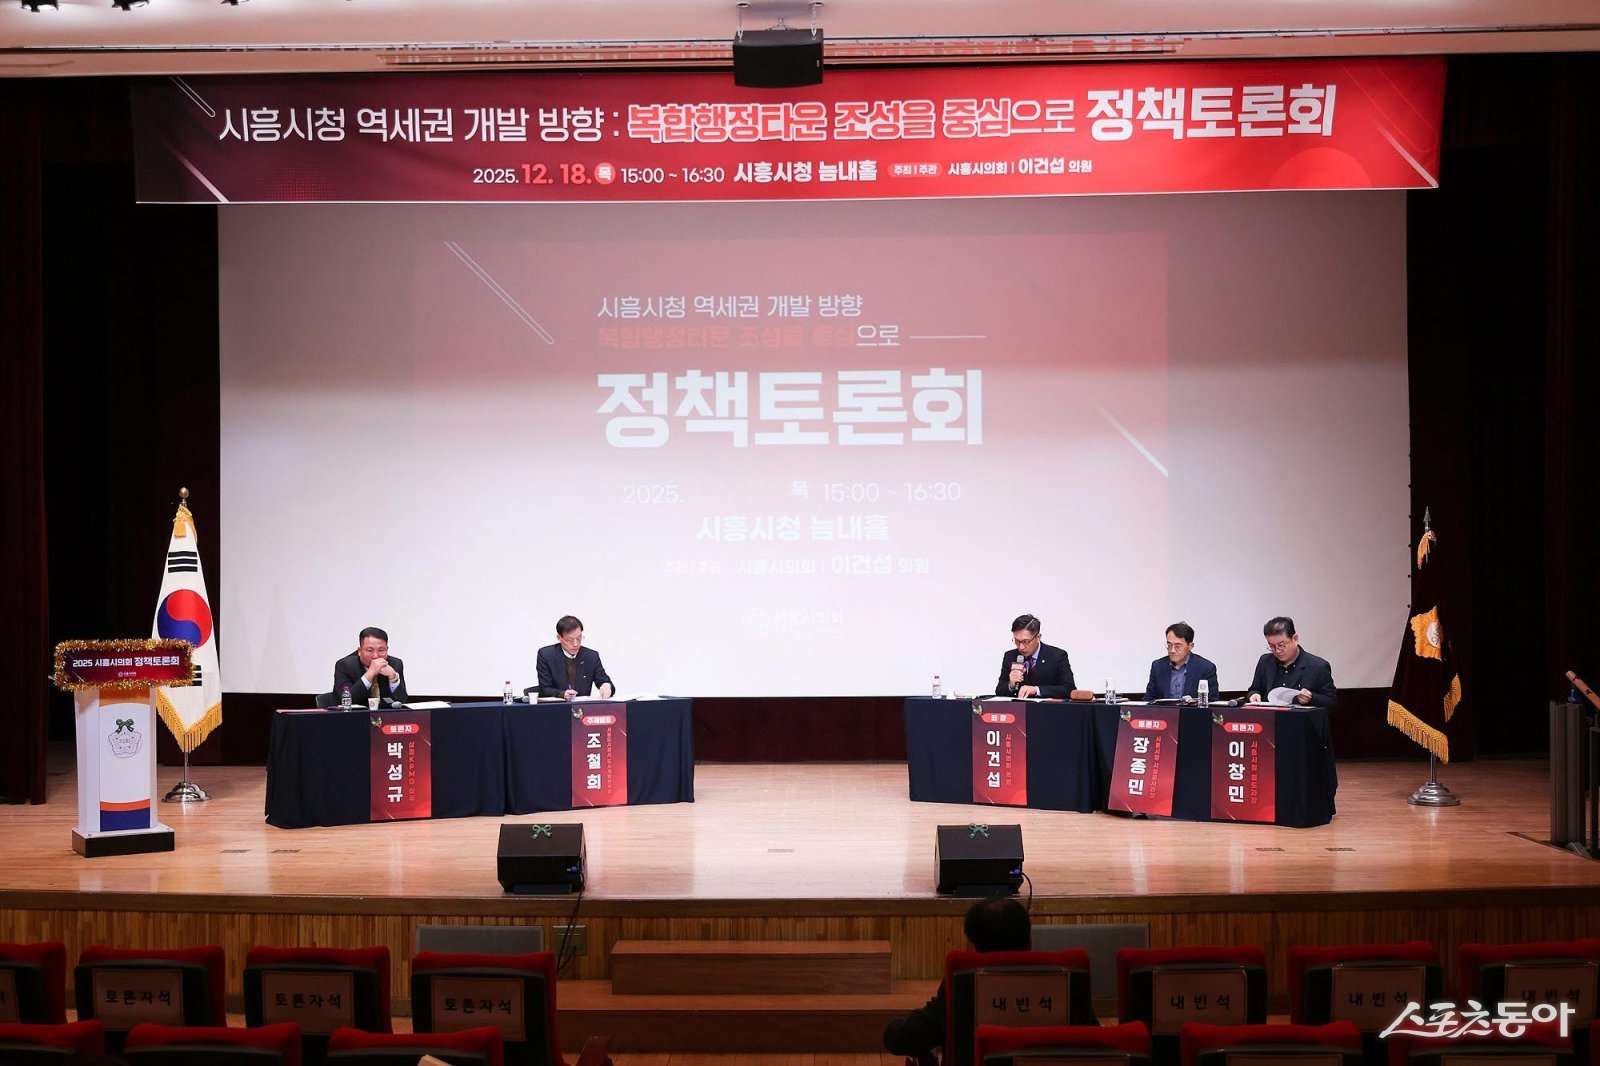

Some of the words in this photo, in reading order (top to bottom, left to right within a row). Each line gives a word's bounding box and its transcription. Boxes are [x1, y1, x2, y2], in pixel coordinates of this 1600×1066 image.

[219, 107, 346, 142] 시흥시청
[357, 107, 454, 142] 역세권
[464, 107, 530, 142] 개발
[538, 106, 604, 142] 방향
[628, 103, 828, 143] 복합행정타운
[834, 99, 935, 140] 조성을
[942, 97, 1075, 139] 중심으로
[1086, 83, 1337, 141] 정책토론회
[473, 168, 519, 184] 2025.
[521, 163, 553, 184] 12.
[560, 163, 592, 184] 18.
[598, 166, 612, 181] 목
[621, 167, 664, 183] 15:00
[682, 167, 725, 183] 16:30
[734, 160, 813, 184] 시흥시청
[818, 160, 878, 183] 늠내홀
[894, 165, 911, 175] 주최
[919, 164, 937, 175] 주관
[948, 161, 1008, 176] 시흥시의회
[1018, 157, 1064, 174] 이건섭
[1068, 160, 1093, 173] 의원
[597, 295, 686, 319] 시흥시청
[693, 295, 759, 318] 역세권
[767, 294, 812, 318] 개발
[818, 294, 863, 317] 방향
[596, 367, 983, 448] 정책토론회
[623, 484, 684, 504] 2025.
[823, 482, 880, 502] 15:00
[904, 482, 961, 502] 16:30
[696, 514, 801, 542] 시흥시청
[810, 513, 889, 541] 늠내홀
[831, 553, 892, 576] 이건섭
[72, 659, 93, 667] 2025
[95, 658, 133, 667] 시흥시의회
[134, 655, 179, 667] 정책토론회
[390, 725, 412, 733] 토론자
[1138, 720, 1160, 728] 토론자
[1232, 723, 1254, 732] 토론자
[587, 733, 601, 789] 조철희
[987, 730, 1000, 787] 이건섭
[1128, 737, 1150, 796] 장종민
[387, 742, 403, 802] 박성규
[1228, 741, 1245, 803] 이창민
[105, 989, 172, 1006] 토론자석
[274, 992, 342, 1009] 토론자석
[443, 998, 512, 1015] 토론자석
[992, 997, 1053, 1013] 내빈석
[1170, 993, 1231, 1011] 내빈석
